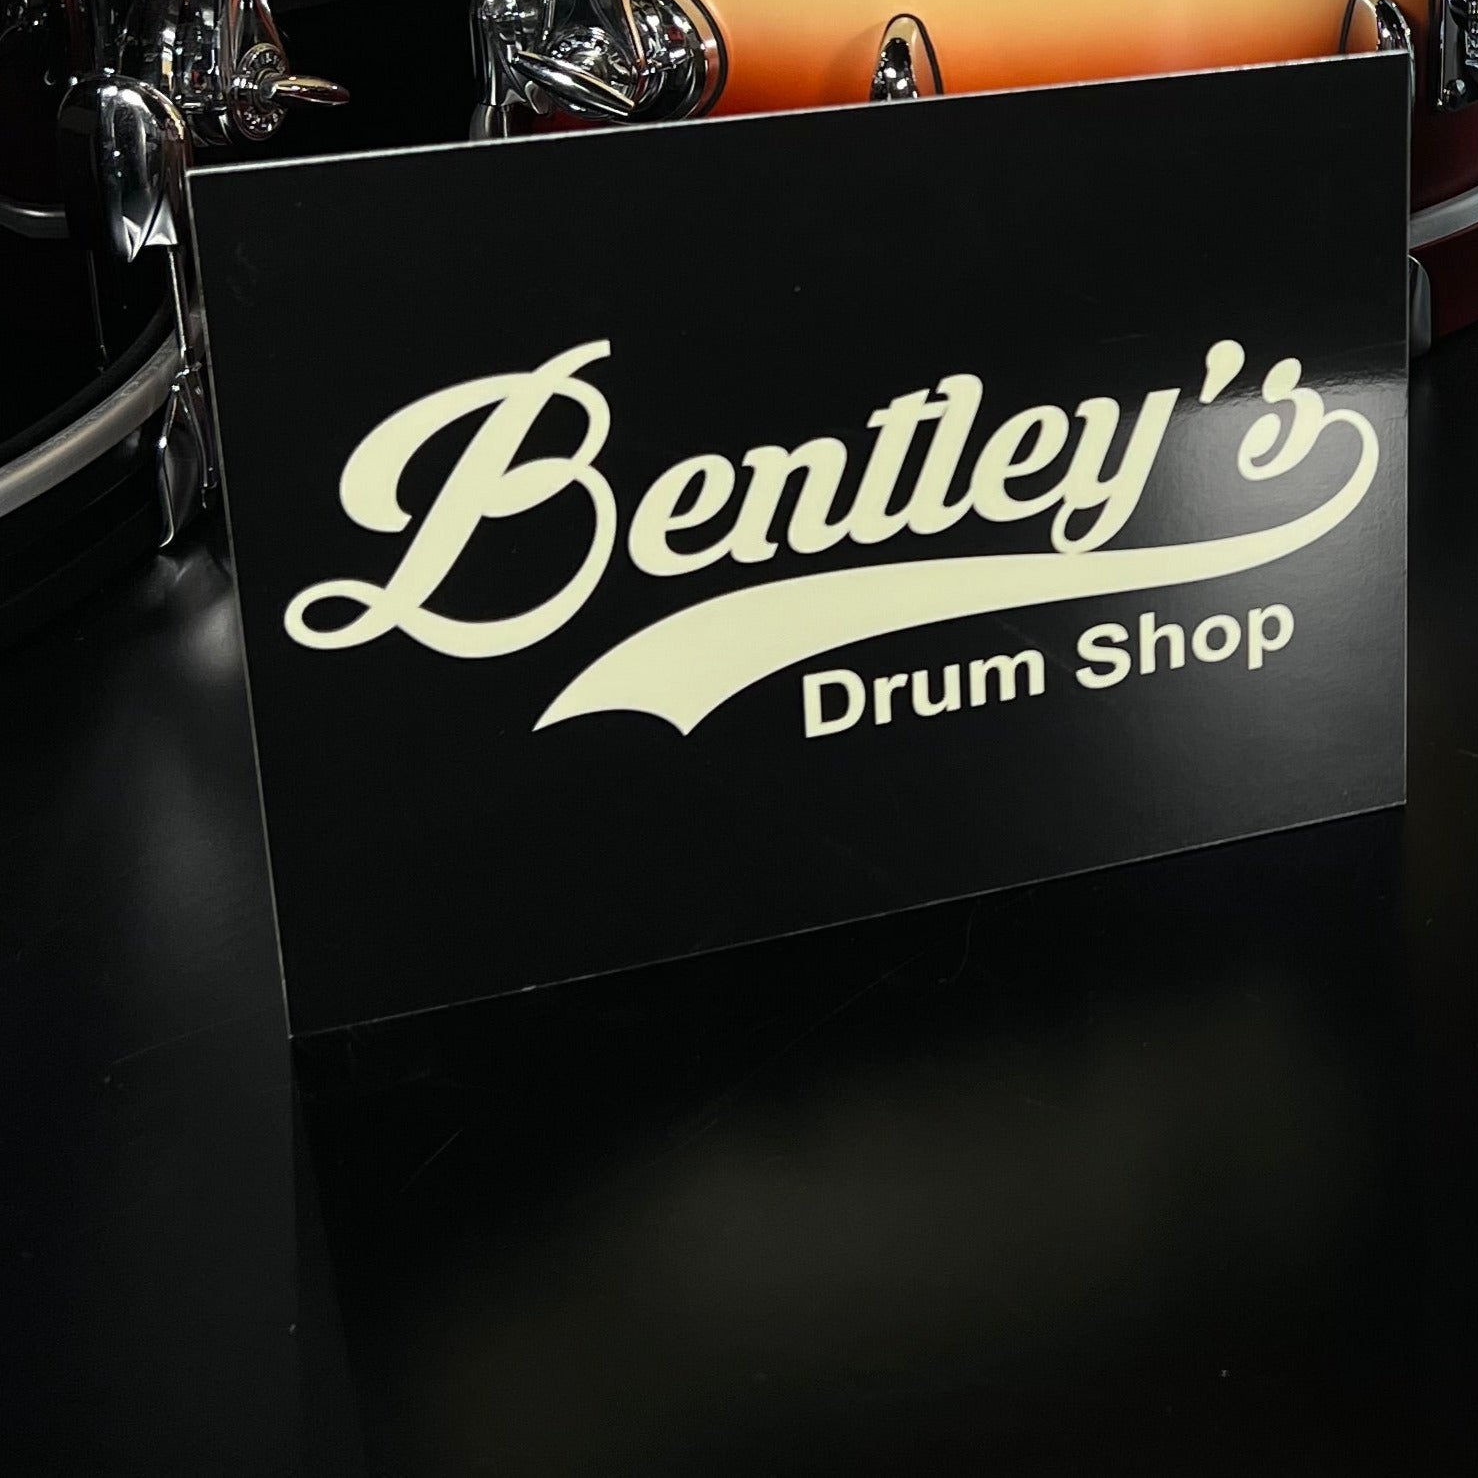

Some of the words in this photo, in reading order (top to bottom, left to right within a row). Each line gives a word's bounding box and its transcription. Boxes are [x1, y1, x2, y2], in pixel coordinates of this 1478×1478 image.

[284, 340, 1378, 658] Bentley's
[803, 650, 1045, 738] Drum
[1076, 604, 1294, 689] Shop
